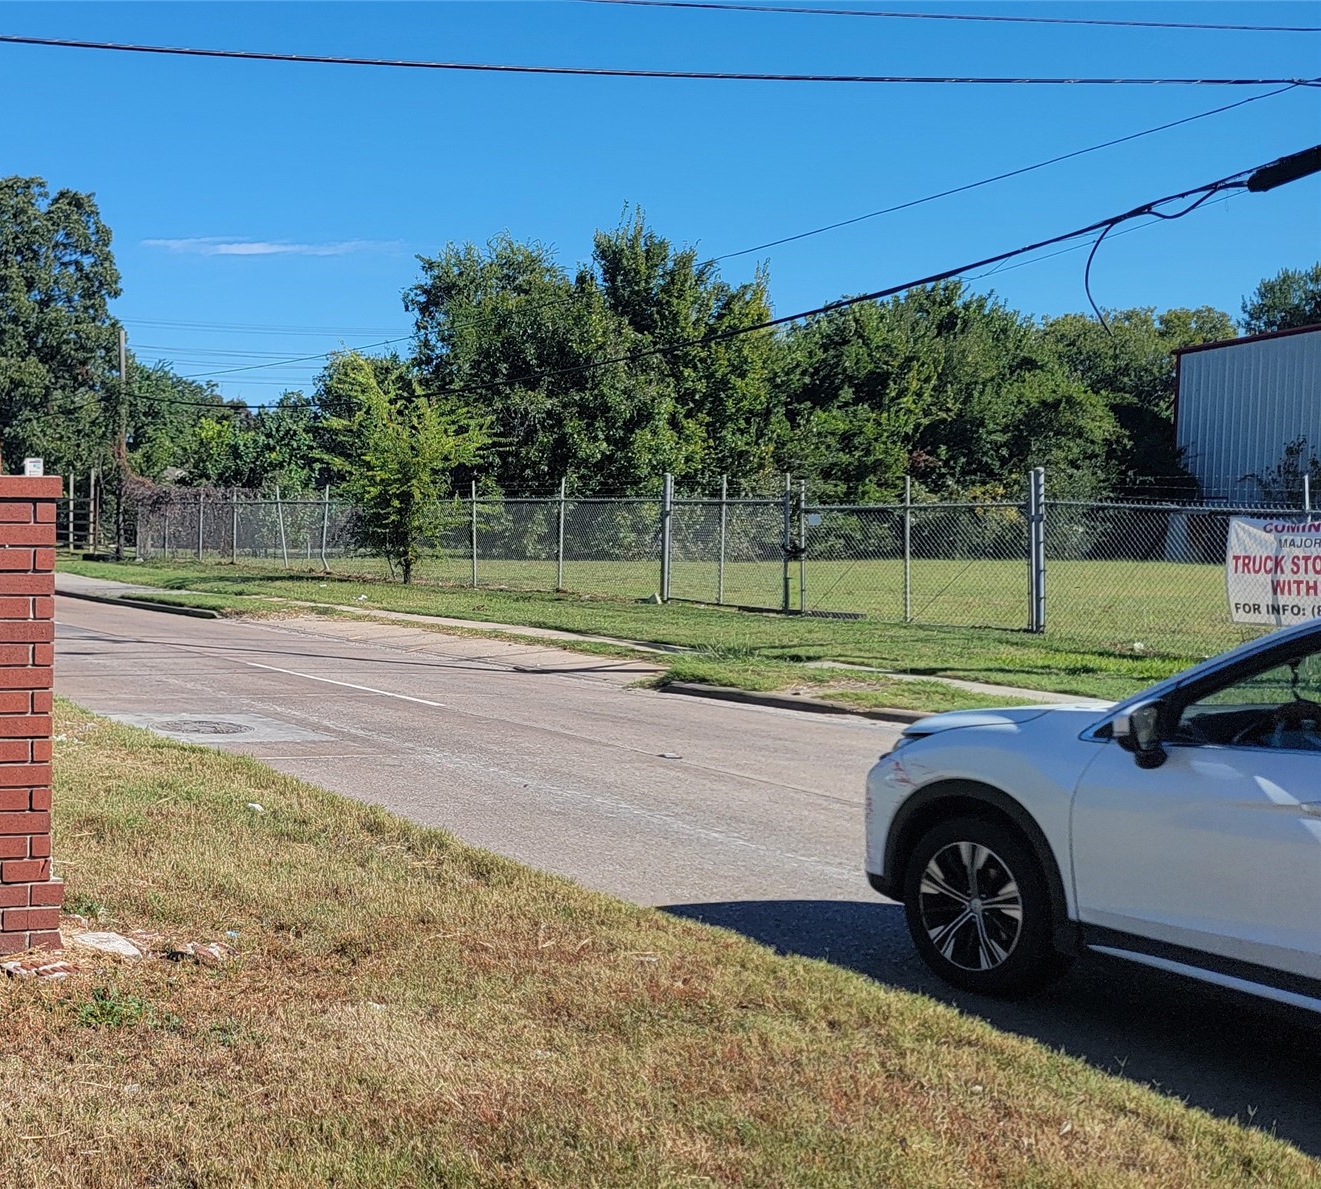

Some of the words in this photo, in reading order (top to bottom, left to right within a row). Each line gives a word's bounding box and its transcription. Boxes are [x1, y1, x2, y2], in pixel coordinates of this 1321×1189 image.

[1232, 554, 1286, 575] TRUCK
[1290, 554, 1321, 575] STO
[1271, 579, 1318, 596] WITH
[1234, 602, 1262, 615] FOR
[1266, 603, 1306, 616] INFO:
